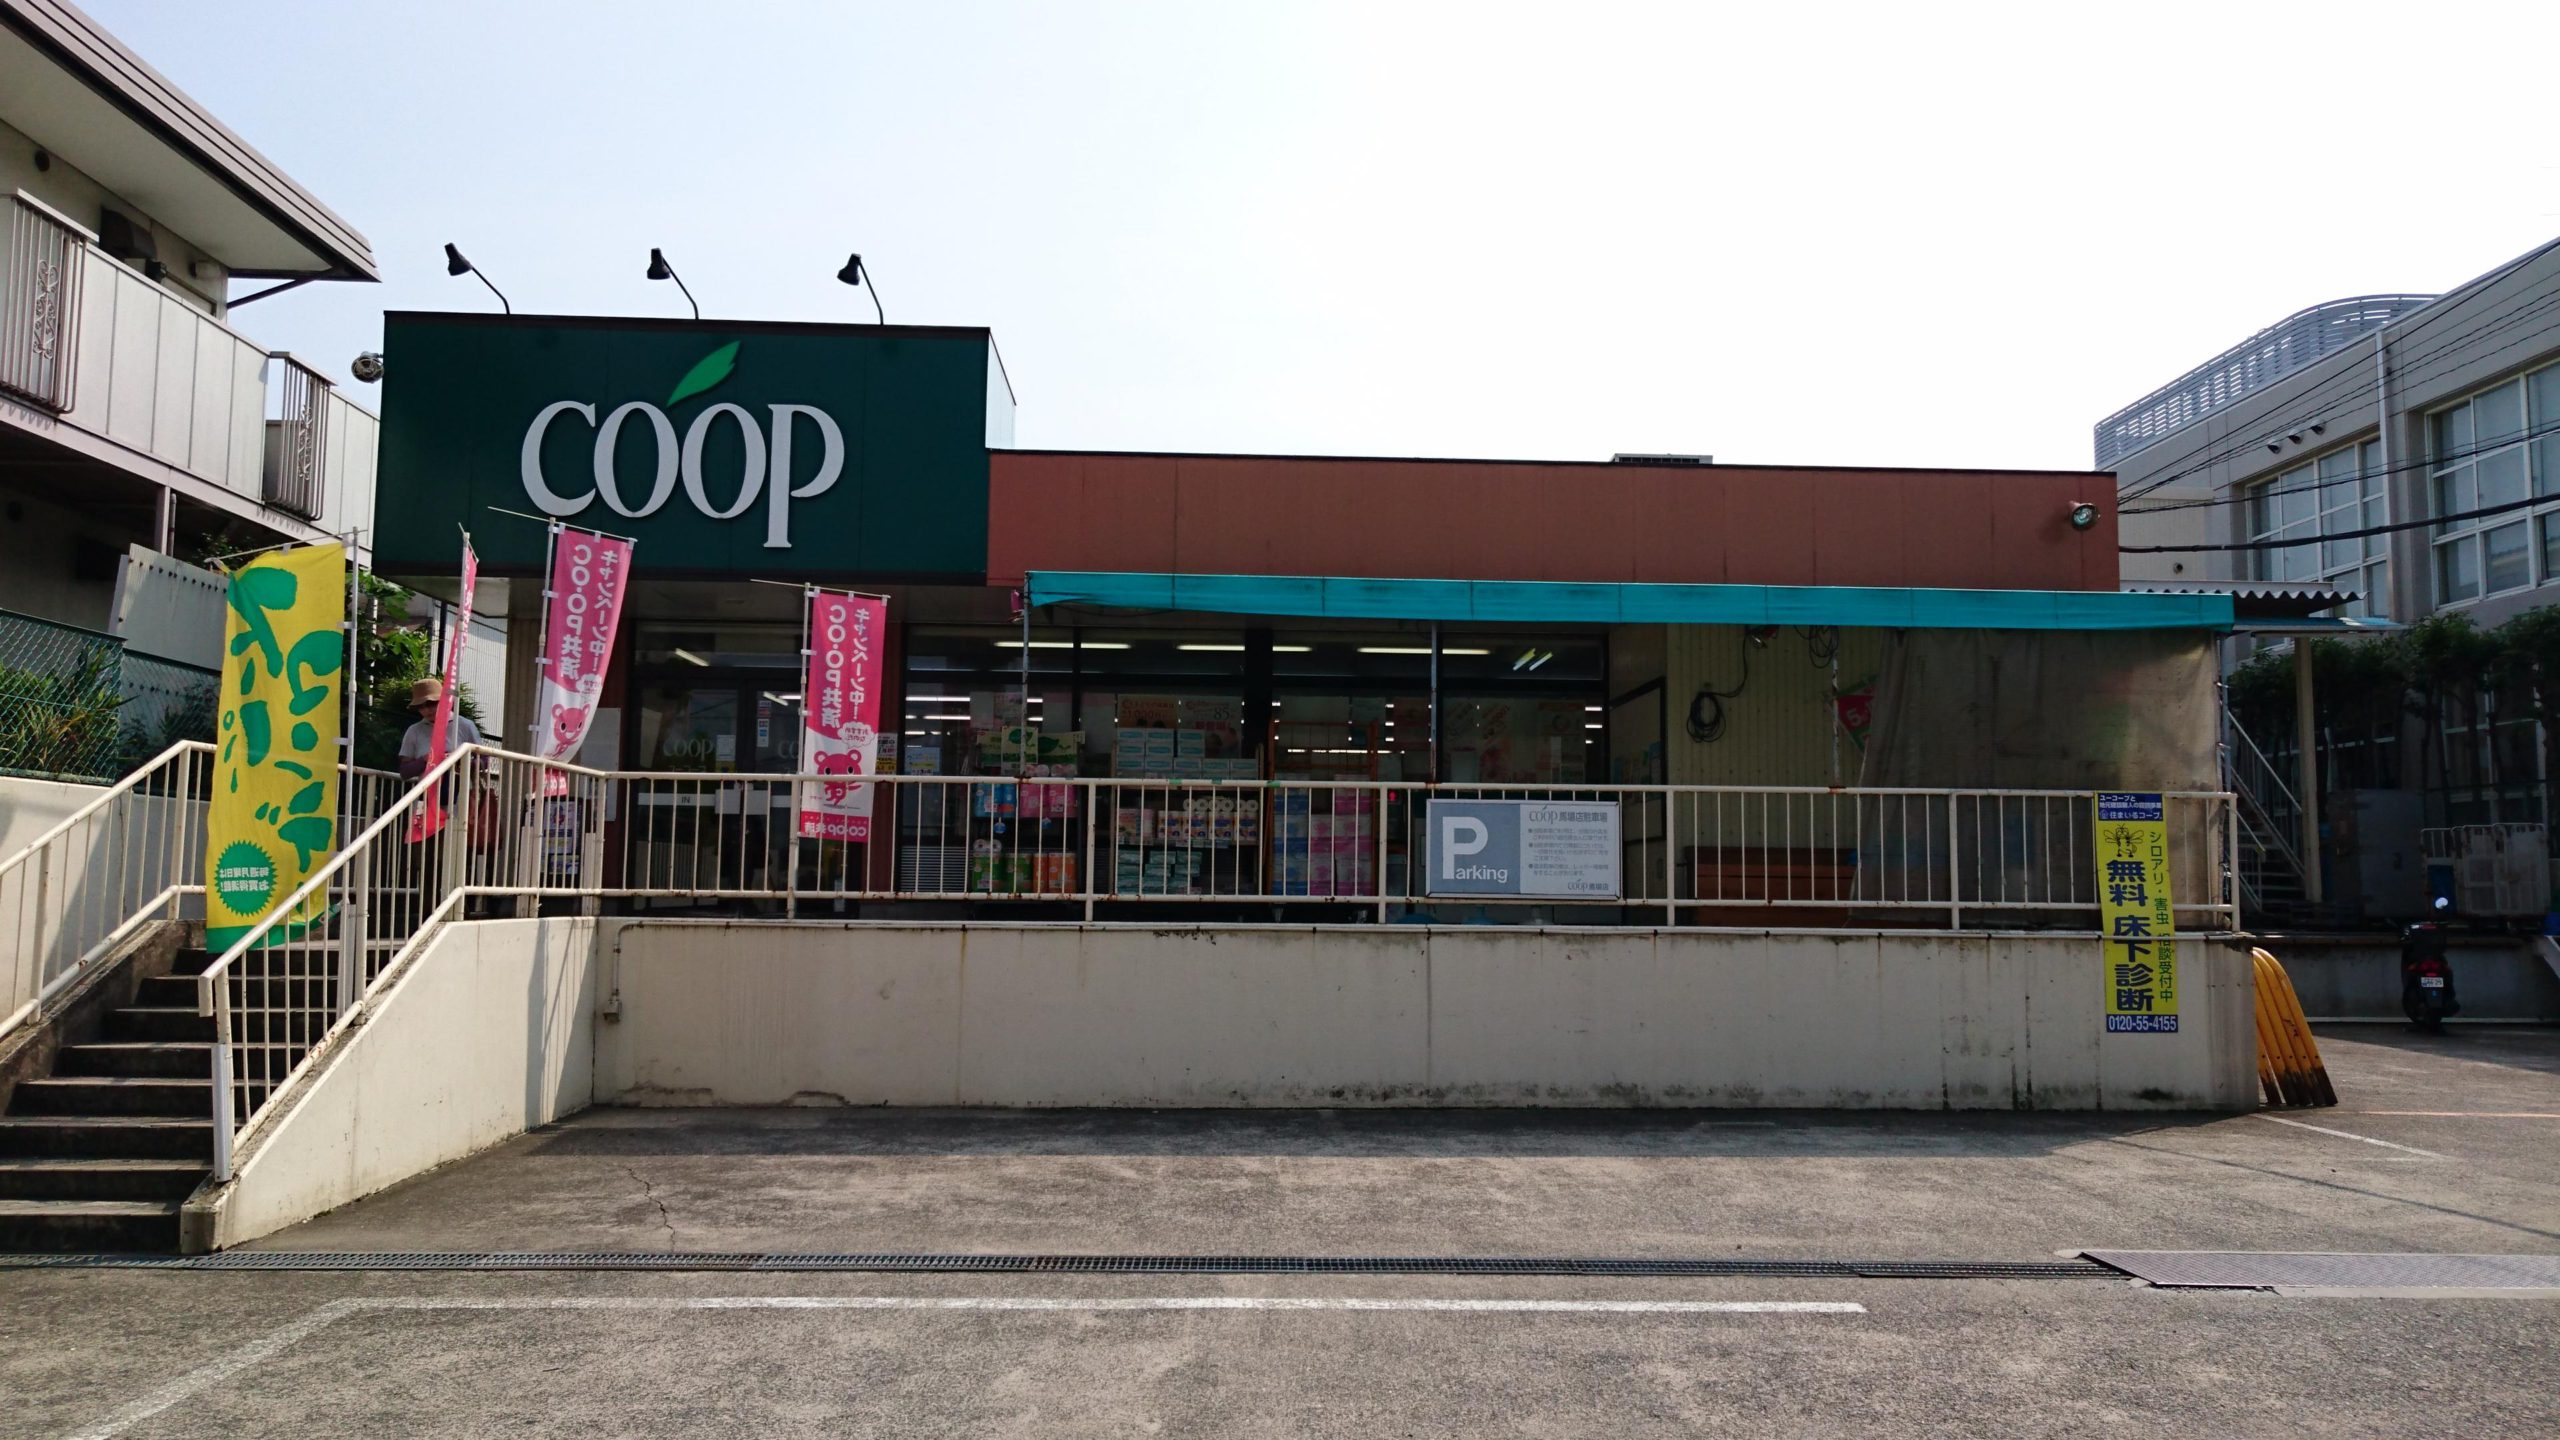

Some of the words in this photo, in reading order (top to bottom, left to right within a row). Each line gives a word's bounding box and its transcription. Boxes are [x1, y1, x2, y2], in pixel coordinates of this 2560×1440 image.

[2106, 859, 2149, 907] 無料
[2113, 914, 2155, 1012] 床下診断
[2108, 1015, 2177, 1031] 0120-55-4155
